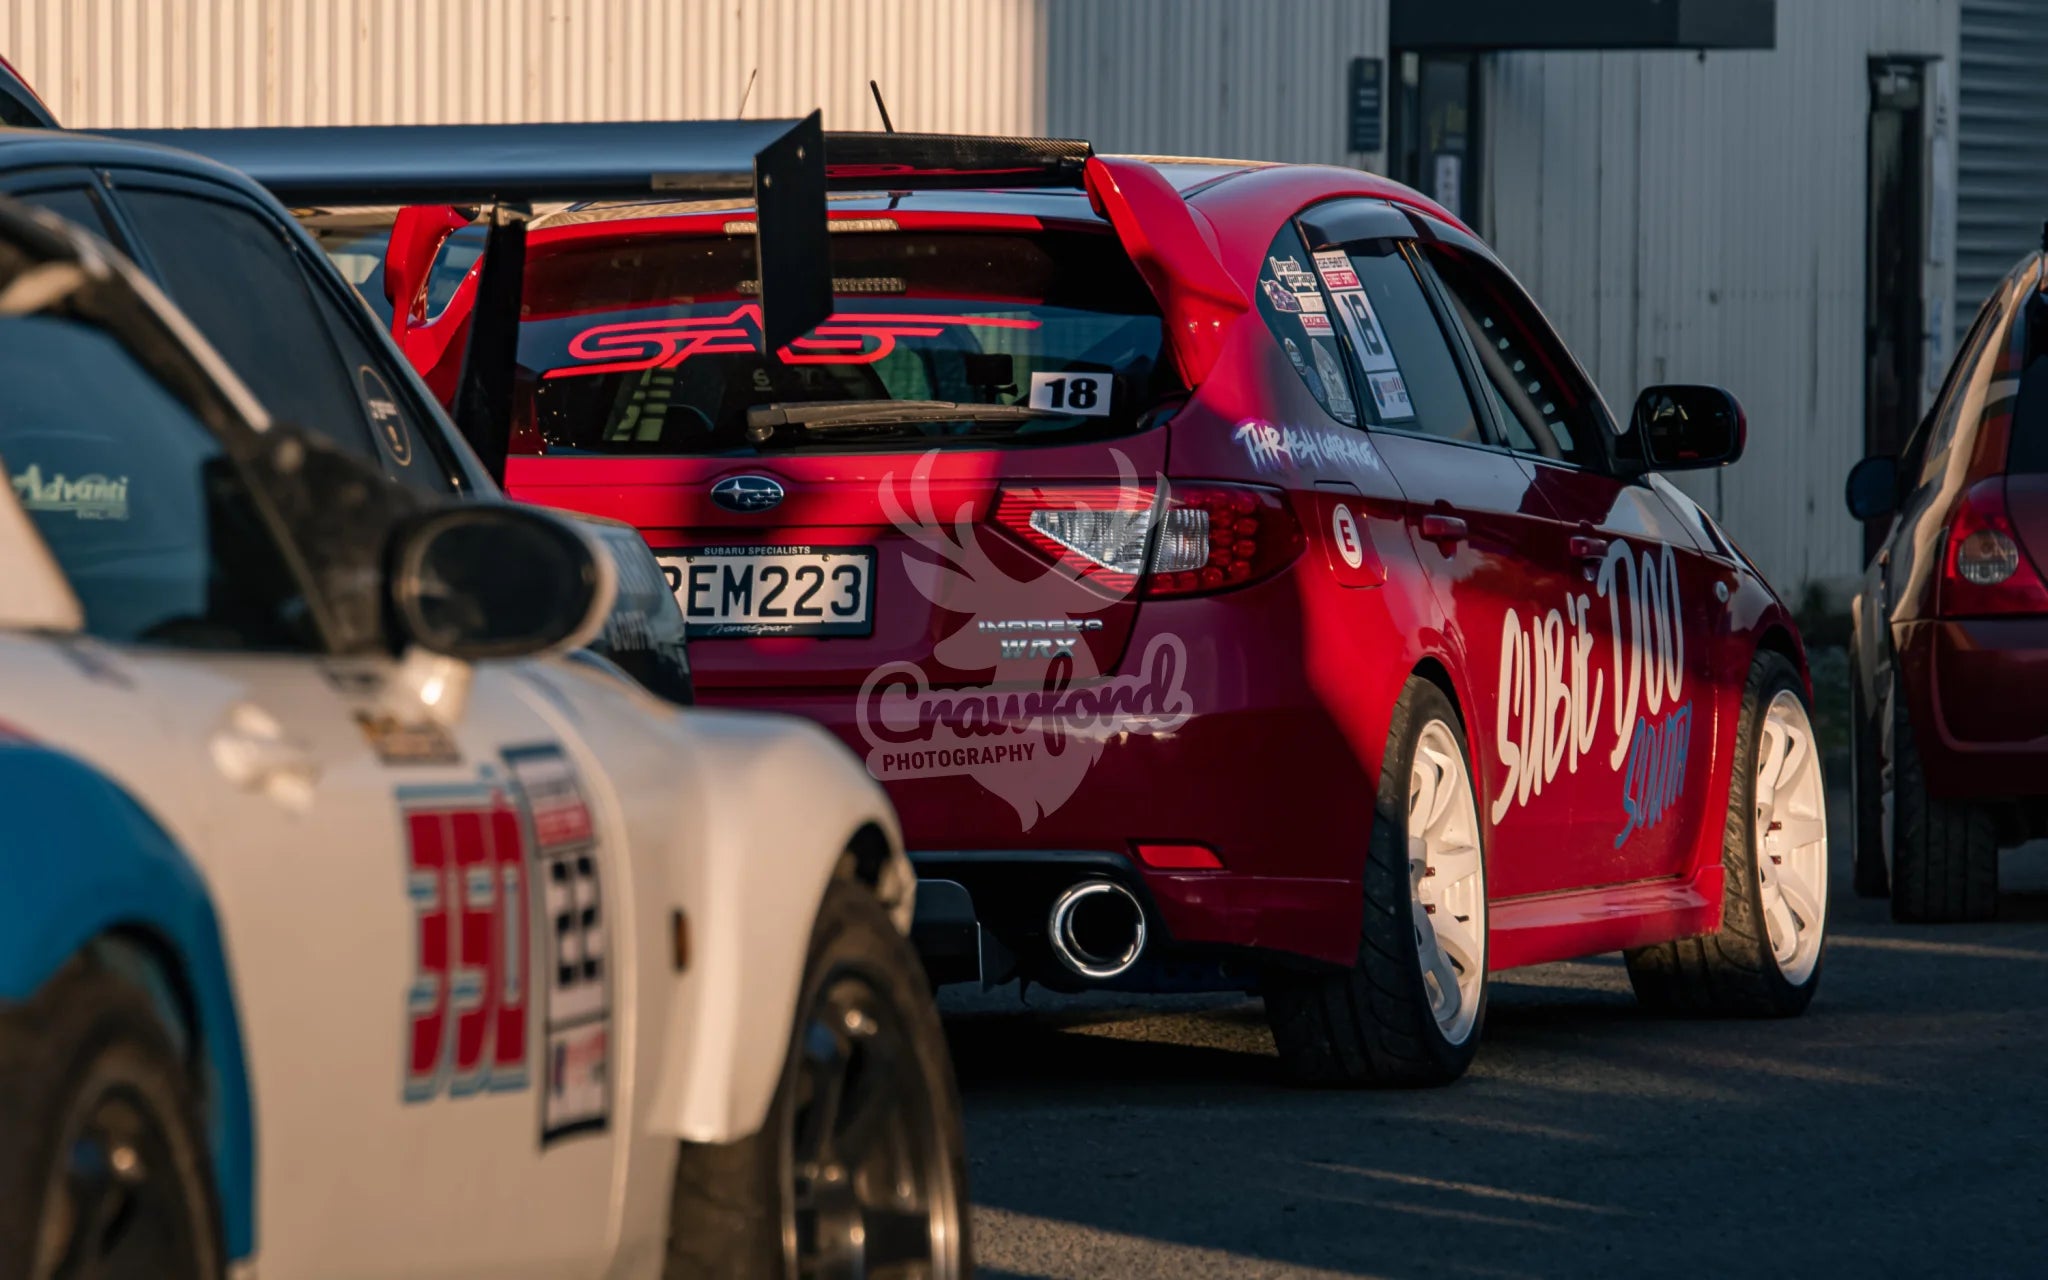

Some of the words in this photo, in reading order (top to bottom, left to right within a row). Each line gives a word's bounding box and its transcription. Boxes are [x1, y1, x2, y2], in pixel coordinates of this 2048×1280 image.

[1341, 293, 1385, 356] 18
[1044, 378, 1098, 409] 18
[704, 546, 746, 556] SUBARU
[748, 546, 811, 555] SPECIALISTS
[1338, 519, 1356, 552] E
[978, 619, 1103, 633] IMPREZA
[1001, 639, 1077, 659] WRX
[1597, 538, 1684, 772] DOO
[1614, 699, 1692, 849] SOUTH
